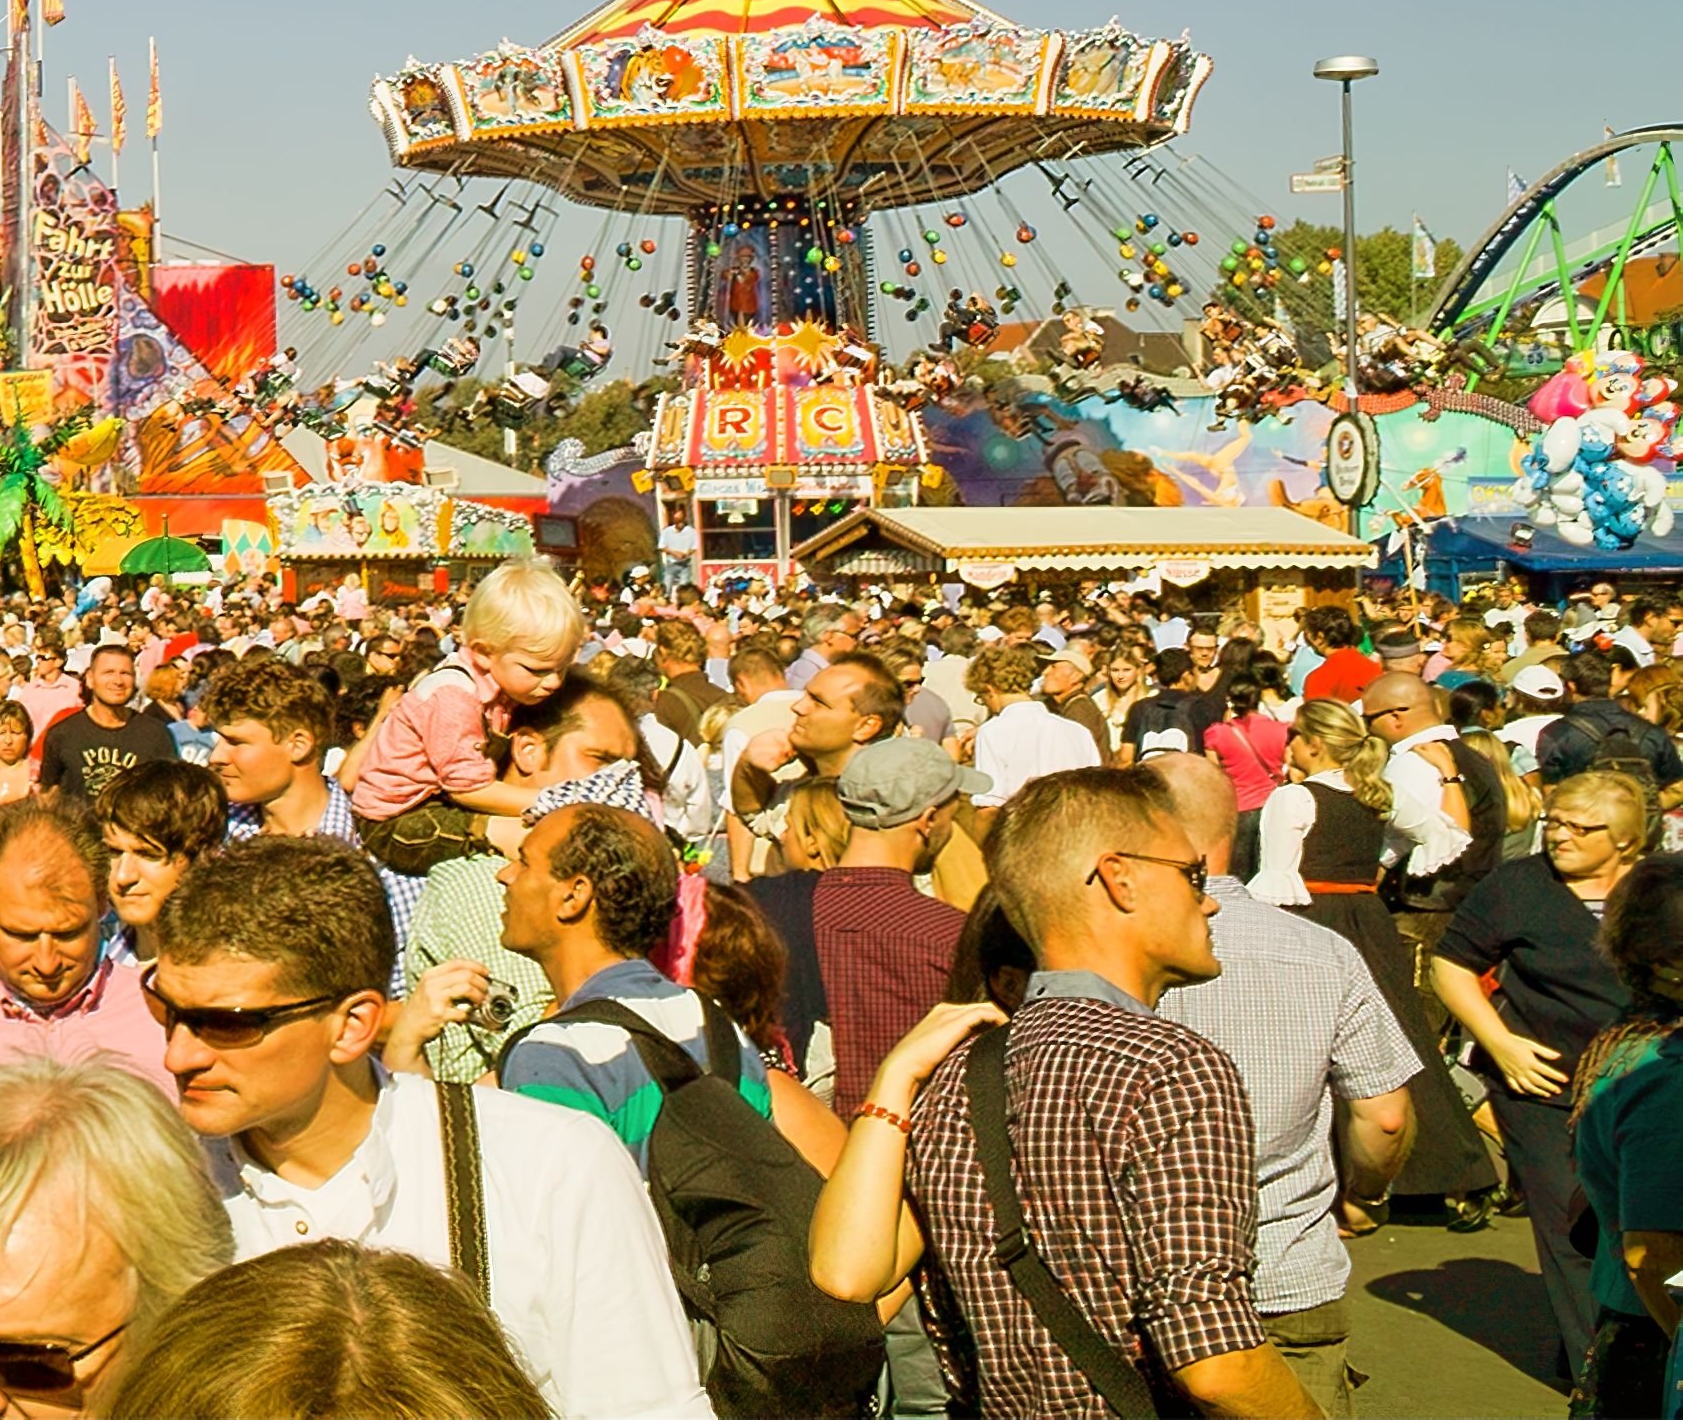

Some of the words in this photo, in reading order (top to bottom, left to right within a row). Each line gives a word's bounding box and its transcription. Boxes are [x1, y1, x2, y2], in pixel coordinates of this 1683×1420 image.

[35, 211, 116, 259] Fahrt
[58, 261, 94, 279] zur
[42, 280, 113, 313] Hölle
[718, 407, 751, 434] R
[814, 407, 844, 432] C
[82, 746, 138, 769] POLO
